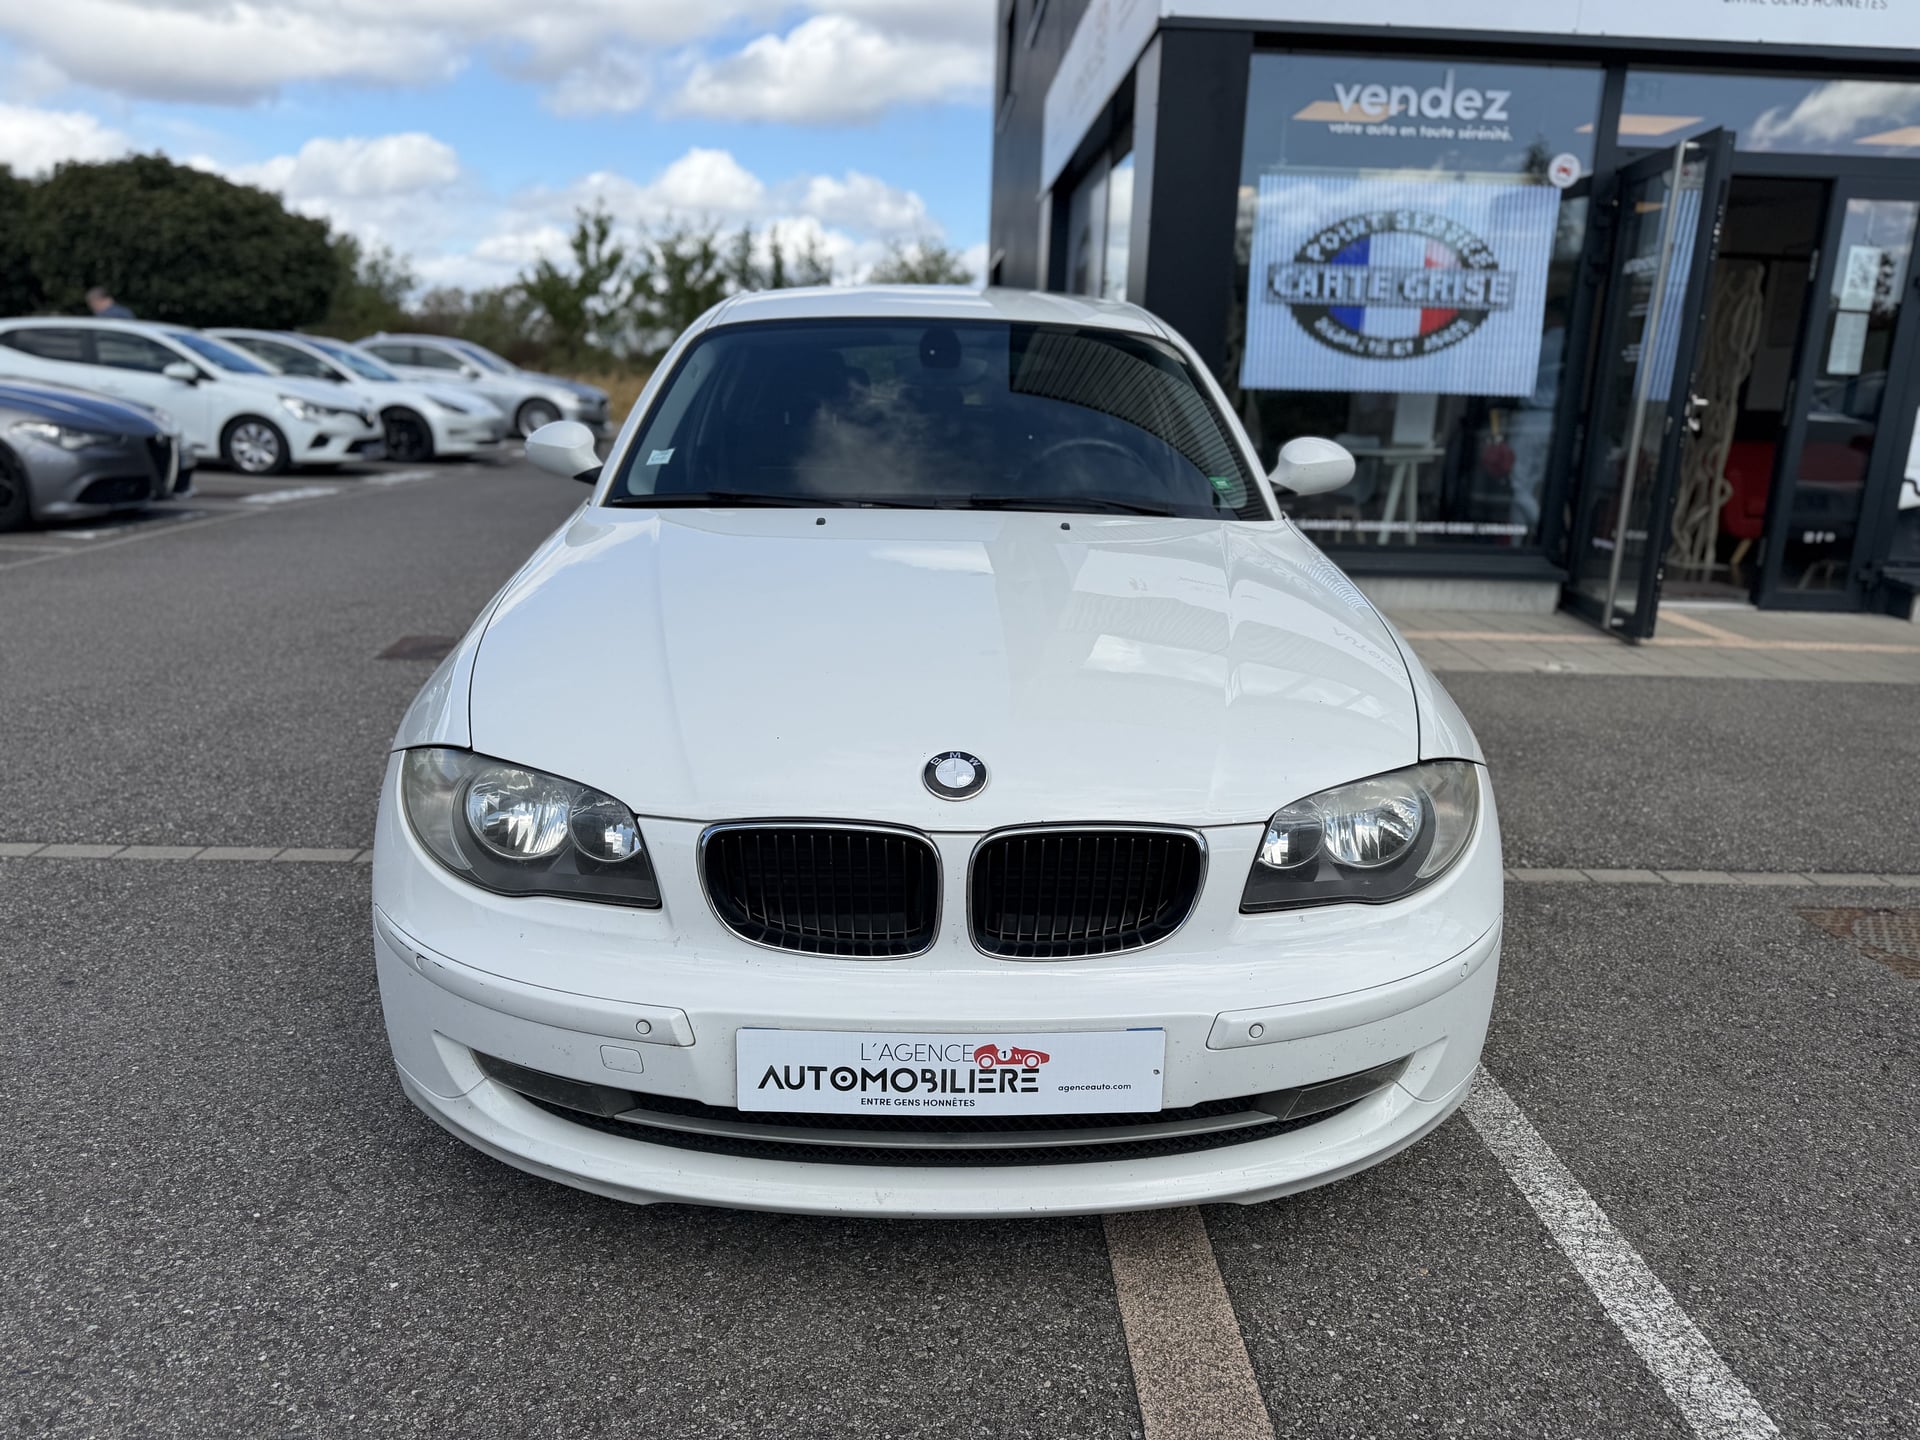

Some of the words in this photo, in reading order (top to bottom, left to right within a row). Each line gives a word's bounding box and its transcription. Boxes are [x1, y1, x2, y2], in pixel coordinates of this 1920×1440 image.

[1333, 69, 1511, 121] vendez
[1328, 123, 1363, 135] votre
[1366, 124, 1397, 137] auto
[1400, 126, 1416, 137] en
[1420, 125, 1454, 139] toute
[1306, 211, 1387, 262] POINT
[1273, 267, 1392, 300] CARTE
[1402, 271, 1511, 304] GRISE
[930, 752, 981, 766] BMW
[1058, 1083, 1132, 1093] agenceauto.com
[860, 1097, 892, 1106] ENTRE
[894, 1098, 921, 1107] GENS
[923, 1097, 976, 1108] HONNÊTES
